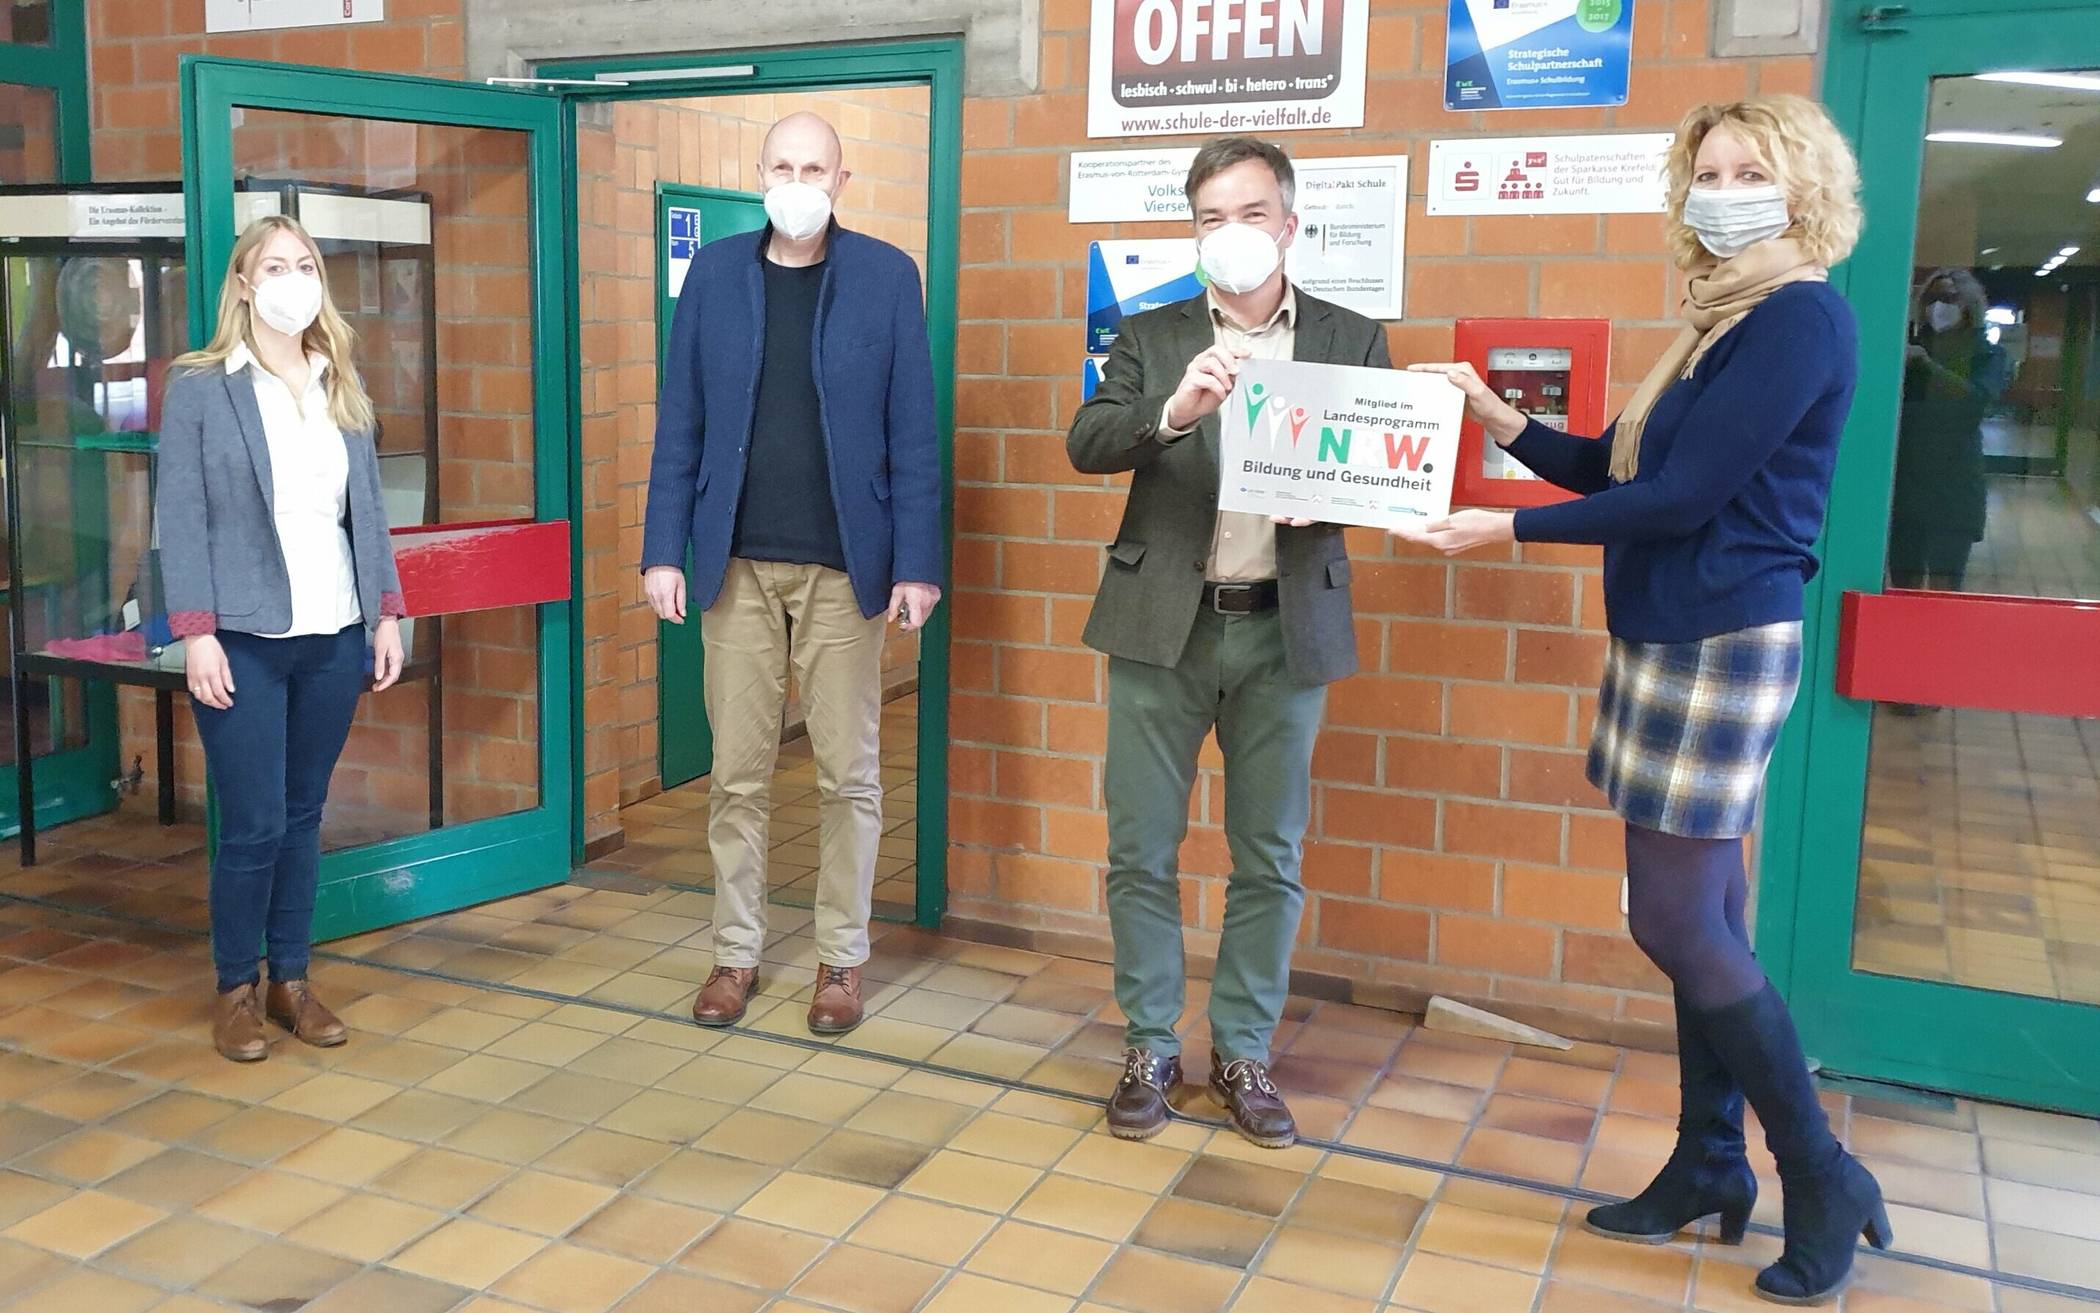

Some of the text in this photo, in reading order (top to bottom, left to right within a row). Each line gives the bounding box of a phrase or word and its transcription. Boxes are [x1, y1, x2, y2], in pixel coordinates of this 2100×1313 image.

[1133, 0, 1324, 65] OFFEN
[1507, 48, 1570, 61] Strategische
[1507, 58, 1603, 73] Schulpartnerschaft
[1121, 80, 1168, 98] lesbisch
[1175, 79, 1217, 96] schwul
[1225, 78, 1237, 93] bi
[1246, 76, 1287, 92] hetero
[1121, 106, 1332, 132] www.schule-der-vielfalt.de
[1078, 160, 1156, 169] Kooperationspartner
[1554, 152, 1646, 164] Schulpatenschaften
[1554, 165, 1570, 174] der
[1571, 164, 1618, 176] Sparkasse
[1357, 178, 1387, 189] Schule
[1553, 174, 1644, 188] Gut für Bildung und
[89, 217, 100, 225] Ein
[685, 213, 691, 237] 1
[1354, 397, 1413, 410] Mitglied im
[1323, 409, 1440, 431] Landesprogramm
[1242, 460, 1432, 492] Bildung und Gesundheit
